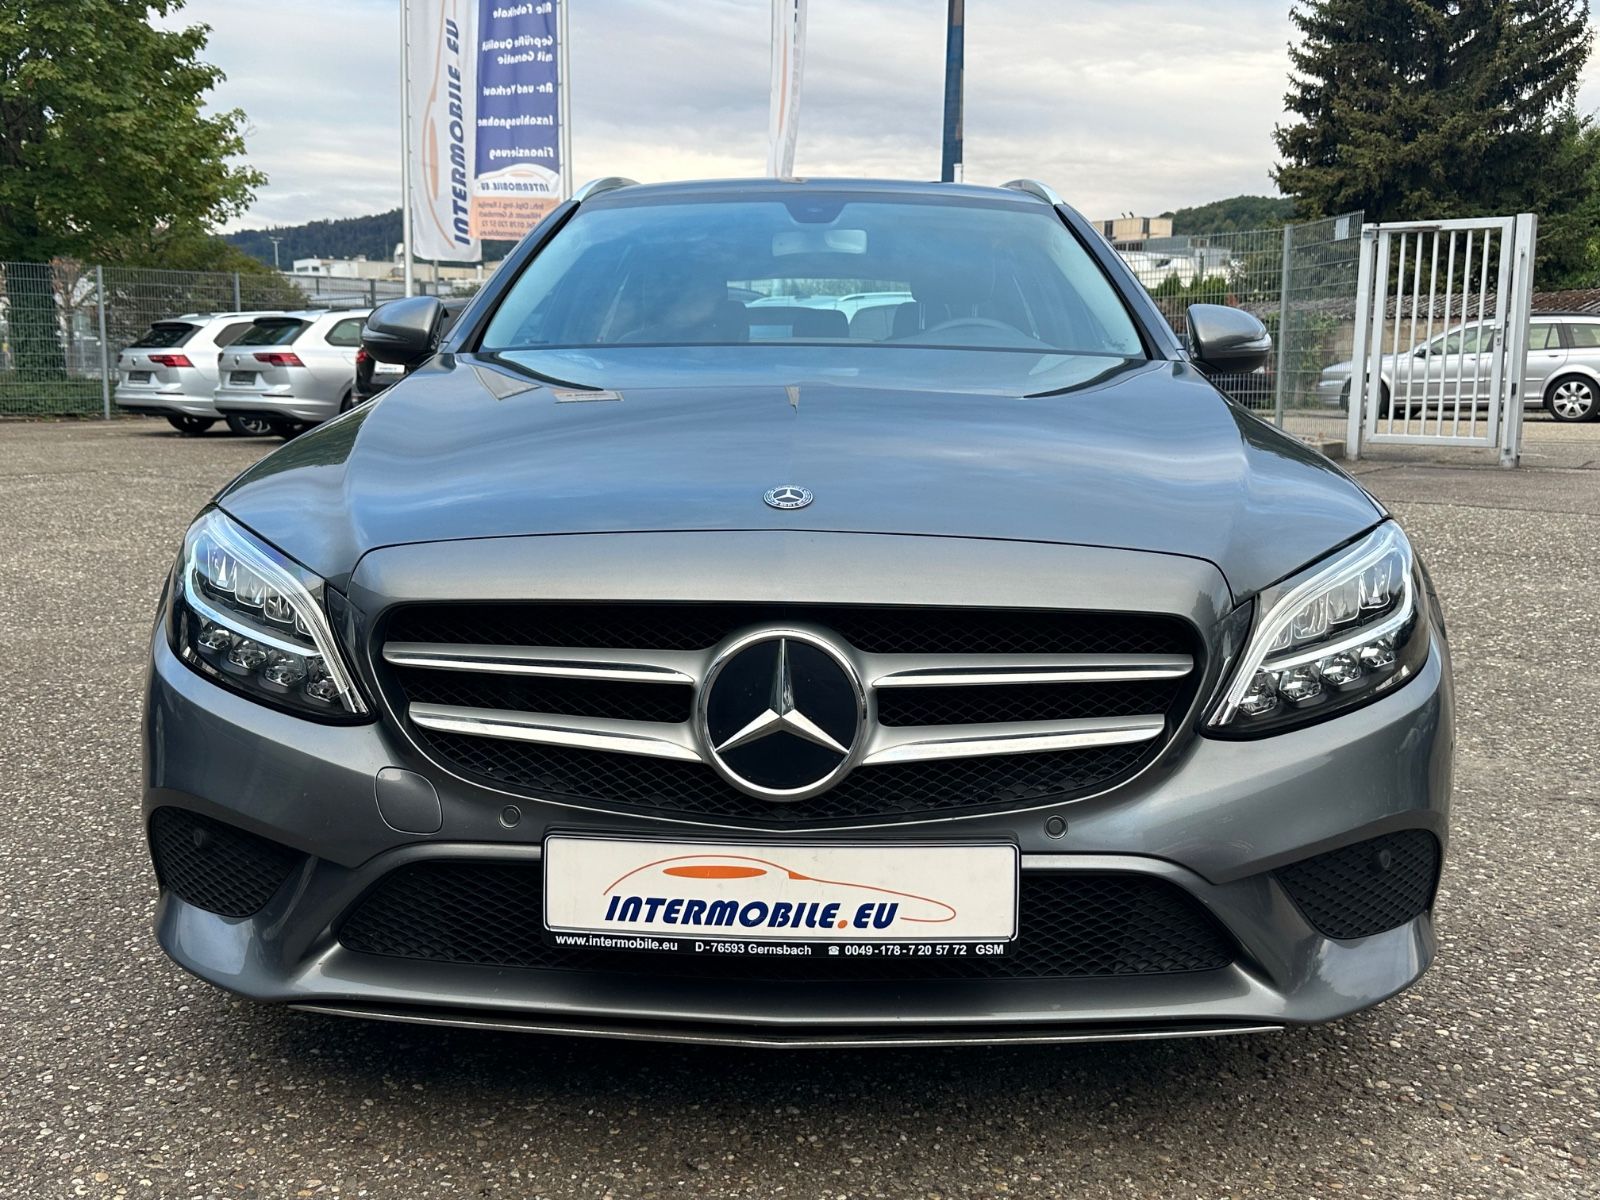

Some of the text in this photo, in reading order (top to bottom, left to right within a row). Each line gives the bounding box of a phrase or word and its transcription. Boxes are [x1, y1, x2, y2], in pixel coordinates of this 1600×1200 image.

[604, 895, 899, 930] INTERMOBILE.EU
[555, 935, 679, 952] www.intermobile.eu
[748, 943, 812, 956] Gernsbach
[975, 944, 1004, 955] GSM
